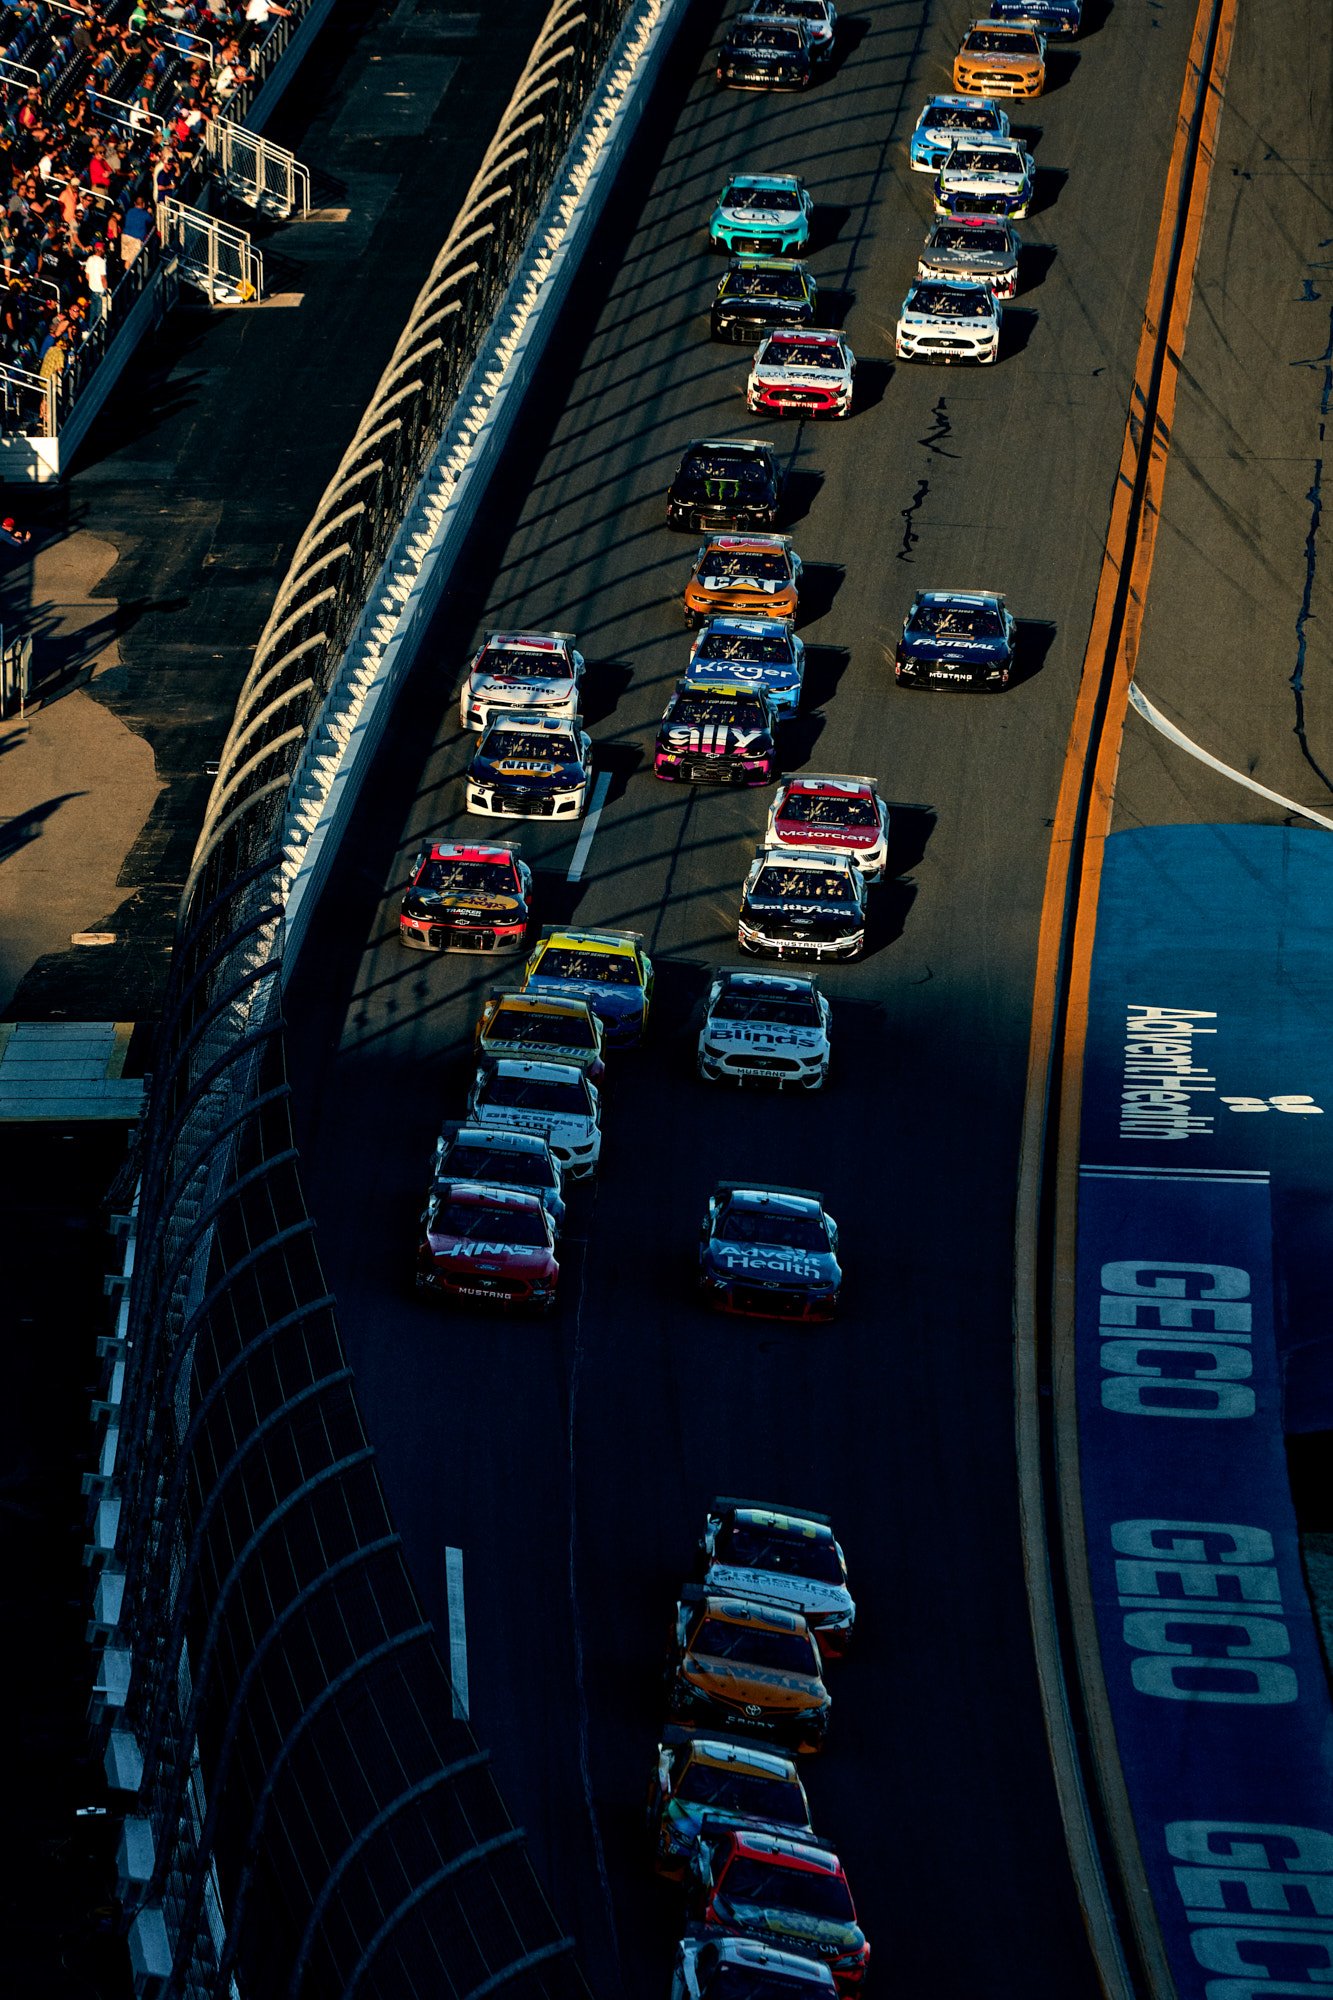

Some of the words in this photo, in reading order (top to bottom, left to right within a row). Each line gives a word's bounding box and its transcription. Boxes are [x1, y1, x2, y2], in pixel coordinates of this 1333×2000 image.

[778, 400, 819, 409] MUSTANG
[703, 575, 783, 594] CAT
[912, 638, 996, 651] FASTENAL
[694, 660, 793, 680] Kroger
[904, 662, 914, 671] 17
[929, 671, 973, 681] MUSTANG
[482, 684, 556, 695] Valvoline
[668, 724, 763, 750] ally
[501, 760, 553, 772] NAPA
[779, 829, 874, 844] Motorcraft
[446, 908, 482, 916] TRACKER
[750, 903, 855, 917] Smithfield
[411, 919, 419, 928] 3
[730, 1021, 816, 1038] Select
[710, 1029, 816, 1049] Blinds
[492, 1040, 592, 1059] PENNZOIL
[736, 1068, 787, 1078] MUSTANG
[1119, 1004, 1218, 1140] AdventHealth
[485, 1112, 585, 1129] DISCOUNT
[717, 1246, 822, 1267] Advent
[726, 1256, 821, 1280] Health
[458, 1286, 513, 1300] MUSTANG
[1099, 1260, 1256, 1420] GEICO
[1110, 1518, 1299, 1705] GEICO
[685, 1661, 825, 1697] DEWALT
